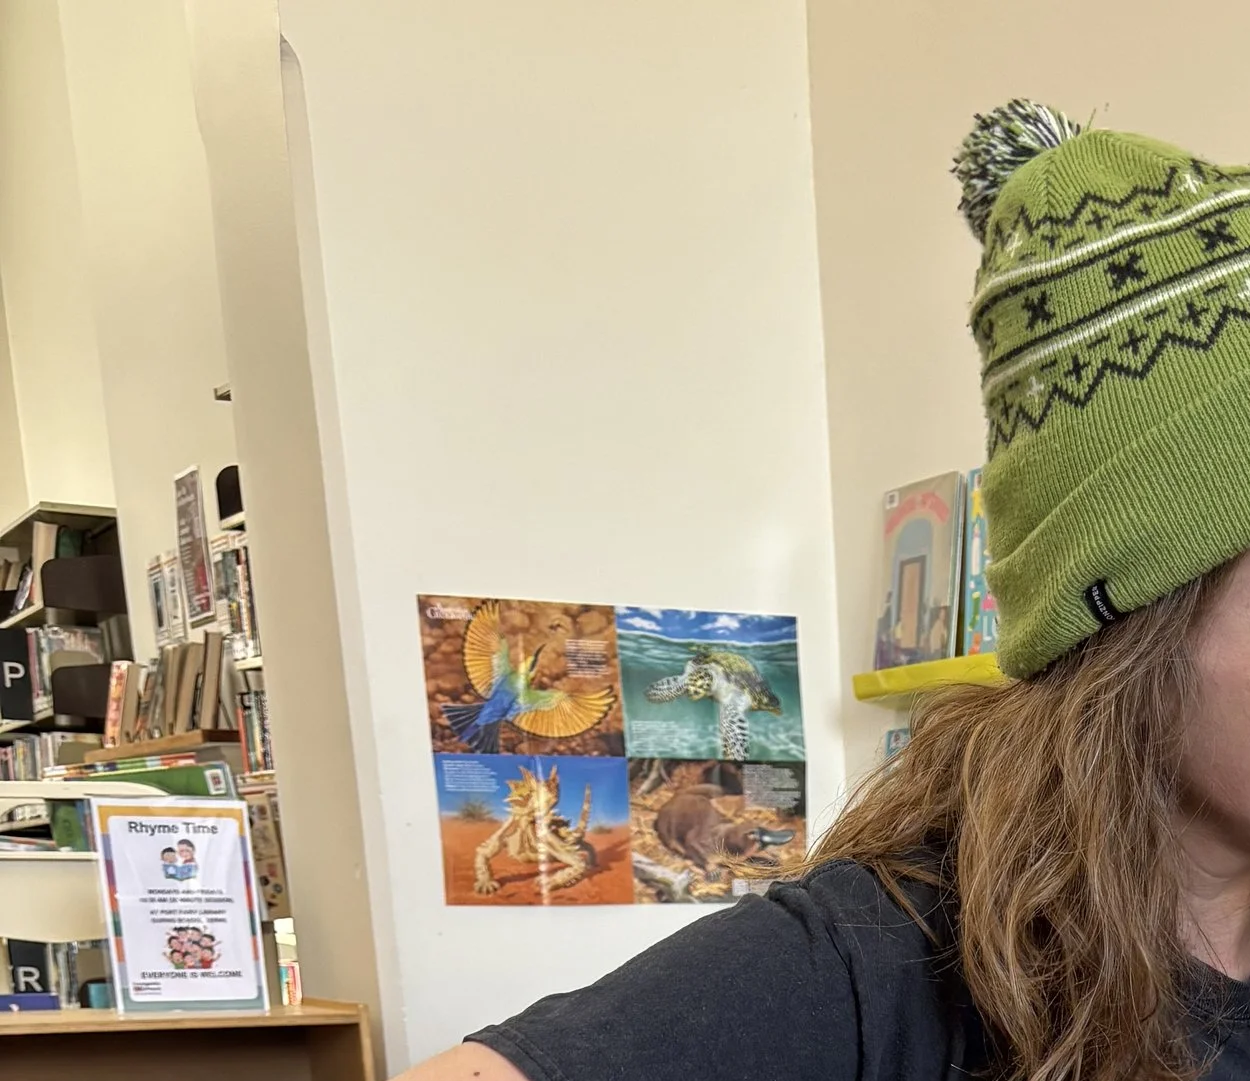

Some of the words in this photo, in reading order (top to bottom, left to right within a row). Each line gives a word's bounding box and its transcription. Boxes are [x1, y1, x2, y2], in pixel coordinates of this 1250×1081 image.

[2, 660, 26, 689] P
[128, 820, 180, 837] Rhyme
[182, 821, 219, 835] Time
[17, 966, 43, 992] R
